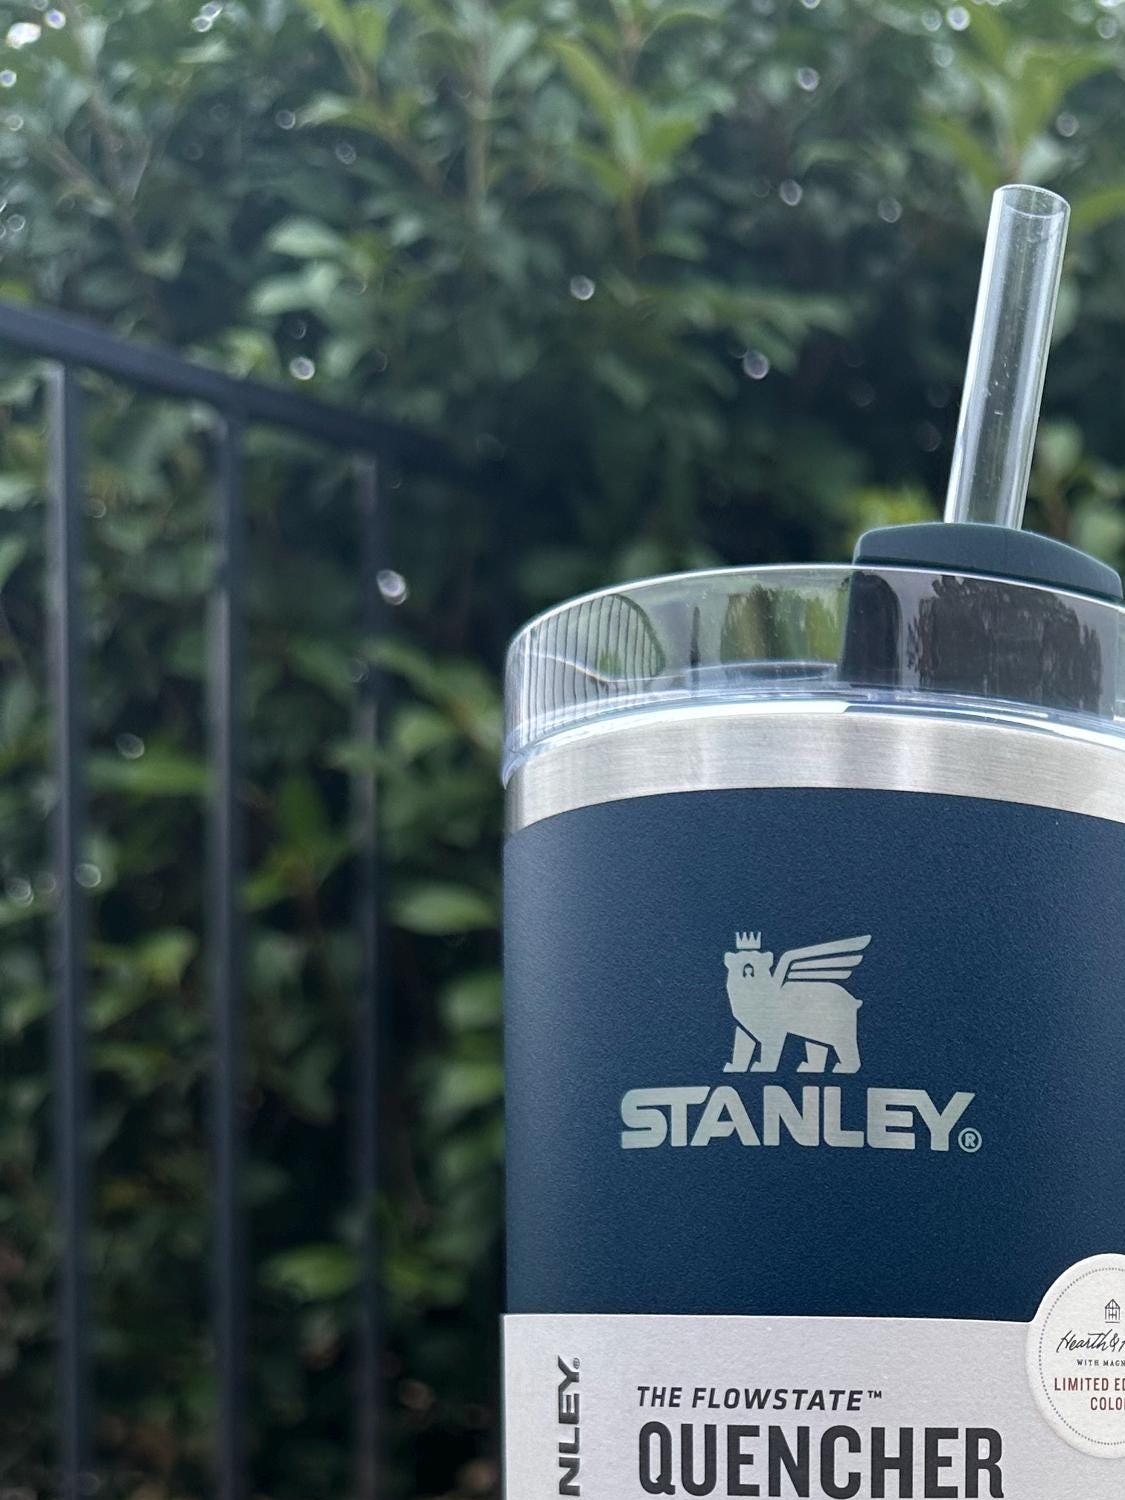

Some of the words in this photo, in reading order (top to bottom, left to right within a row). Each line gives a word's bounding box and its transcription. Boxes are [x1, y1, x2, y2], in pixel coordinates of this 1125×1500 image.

[1076, 1359, 1100, 1367] WITH
[1054, 1377, 1109, 1391] LIMITED
[637, 1386, 683, 1408] THE
[638, 1420, 1004, 1499] QUENCHER
